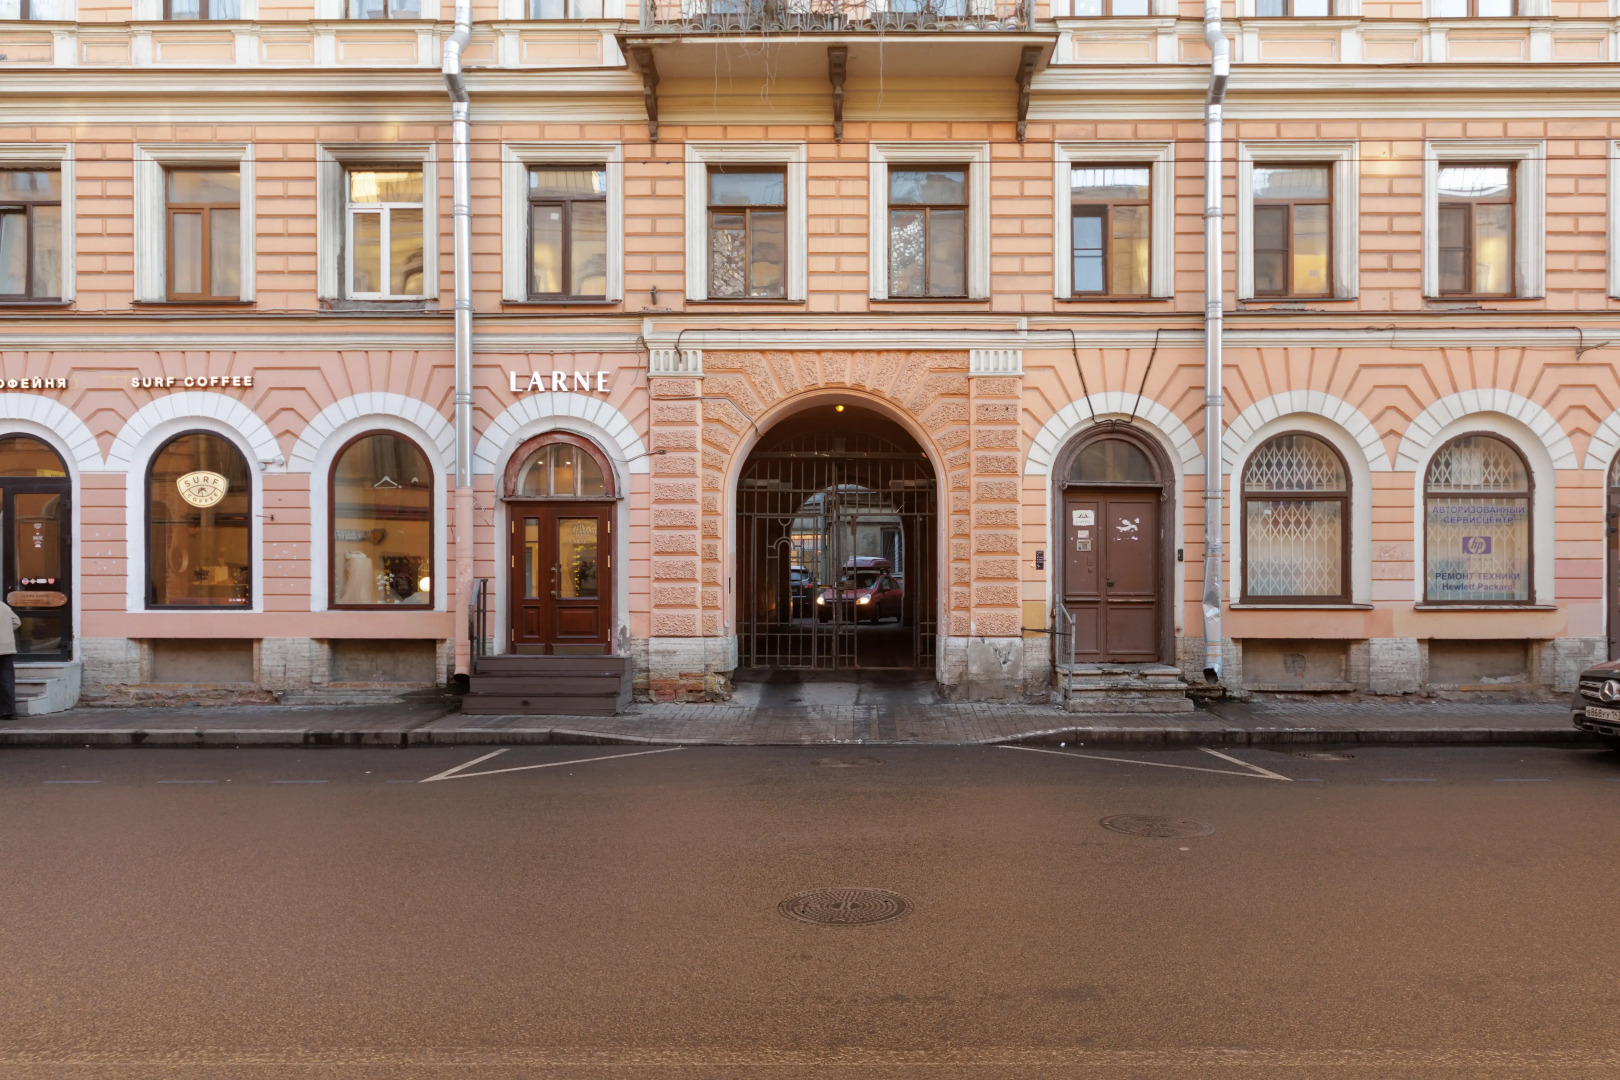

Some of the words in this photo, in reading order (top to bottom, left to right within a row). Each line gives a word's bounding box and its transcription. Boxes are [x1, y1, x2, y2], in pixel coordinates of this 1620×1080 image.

[131, 376, 175, 388] SURF
[184, 376, 253, 387] COFFEE
[509, 370, 611, 392] LARNE
[184, 475, 219, 487] SURF
[1432, 505, 1525, 514] АВТОРИЗОВАННЫЙ
[1435, 572, 1474, 580] РЕМОНТ
[1477, 572, 1520, 580] ТЕХНИКИ
[1442, 583, 1475, 591] Hewlett
[1477, 583, 1513, 591] Packard
